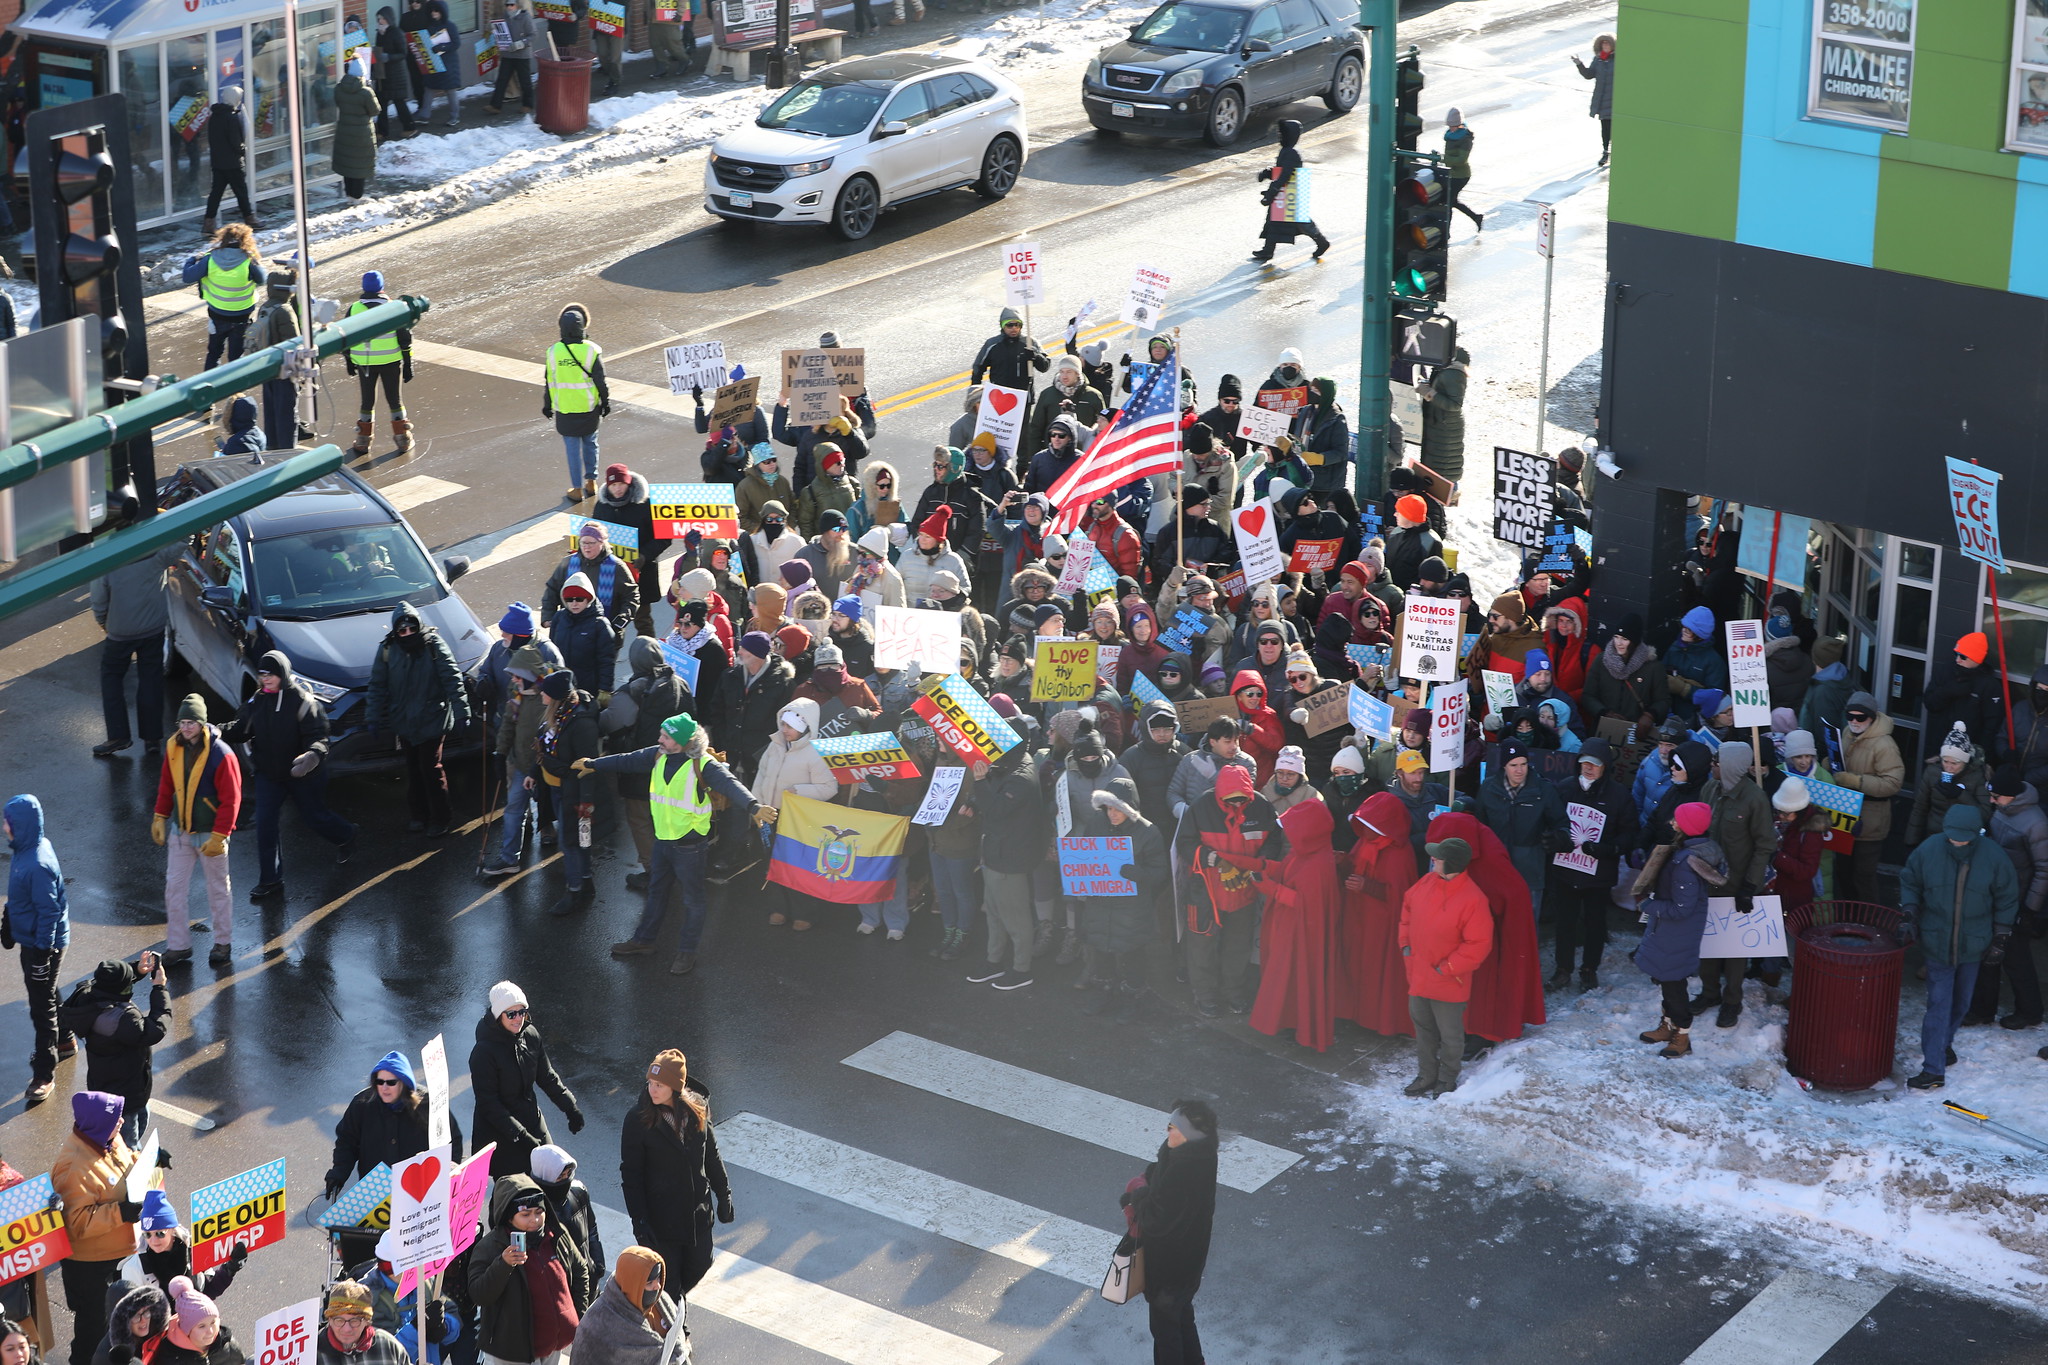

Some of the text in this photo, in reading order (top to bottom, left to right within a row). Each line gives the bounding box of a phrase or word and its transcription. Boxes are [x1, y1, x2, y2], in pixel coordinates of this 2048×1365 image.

[595, 21, 617, 34] MSP
[1830, 3, 1907, 33] 358-2000
[1822, 46, 1908, 87] MAX LIFE
[1824, 78, 1910, 104] CHIROPRACTIC
[1010, 251, 1033, 263] ICE
[1008, 263, 1037, 275] OUT
[667, 342, 723, 369] NO BORDERS
[803, 355, 828, 367] KEEP
[701, 366, 728, 389] LAND
[807, 368, 825, 379] THE
[800, 410, 831, 423] RACISTS
[1496, 450, 1550, 484] LESS
[1498, 474, 1554, 511] ICE
[653, 505, 734, 519] ICE OUT
[1952, 490, 1992, 533] ICE
[672, 521, 719, 537] MSP
[1499, 522, 1545, 548] NICE
[1295, 545, 1321, 553] STAND
[1959, 522, 1999, 562] OUT!
[1300, 553, 1319, 561] WITH
[1408, 604, 1455, 617] ¡SOMOS
[1408, 615, 1456, 626] VALIENTES!
[881, 613, 919, 636] NO
[1406, 633, 1454, 645] NUESTRAS
[1410, 641, 1451, 652] FAMILIAS
[879, 634, 955, 666] FEAR
[1049, 646, 1089, 664] Love
[1101, 647, 1120, 657] ARE
[1731, 644, 1763, 659] STOP
[1055, 664, 1074, 680] thy
[1036, 676, 1091, 699] Neighbor
[1442, 692, 1463, 712] ICE
[929, 687, 1003, 757] ICE OUT
[1437, 708, 1464, 729] OUT
[929, 712, 974, 753] MSP
[1441, 729, 1449, 738] of
[824, 748, 903, 768] ICE OUT
[849, 764, 896, 780] MSP
[936, 769, 963, 779] WE ARE
[916, 810, 948, 821] FAMILY
[1569, 805, 1604, 826] WE ARE
[1061, 837, 1128, 851] FUCK ICE
[1063, 863, 1111, 877] CHINGA
[1557, 852, 1596, 869] FAMILY
[1071, 880, 1135, 894] LA MIGRA
[1741, 919, 1779, 948] NO
[193, 1190, 284, 1244] ICE OUT
[401, 1202, 442, 1223] Love Your
[7, 1207, 57, 1245] OUT
[399, 1214, 441, 1236] Immigrant
[213, 1224, 265, 1262] MSP
[403, 1228, 440, 1248] Neighbor
[0, 1242, 46, 1281] MSP
[265, 1316, 305, 1347] ICE
[260, 1335, 310, 1365] OUT
